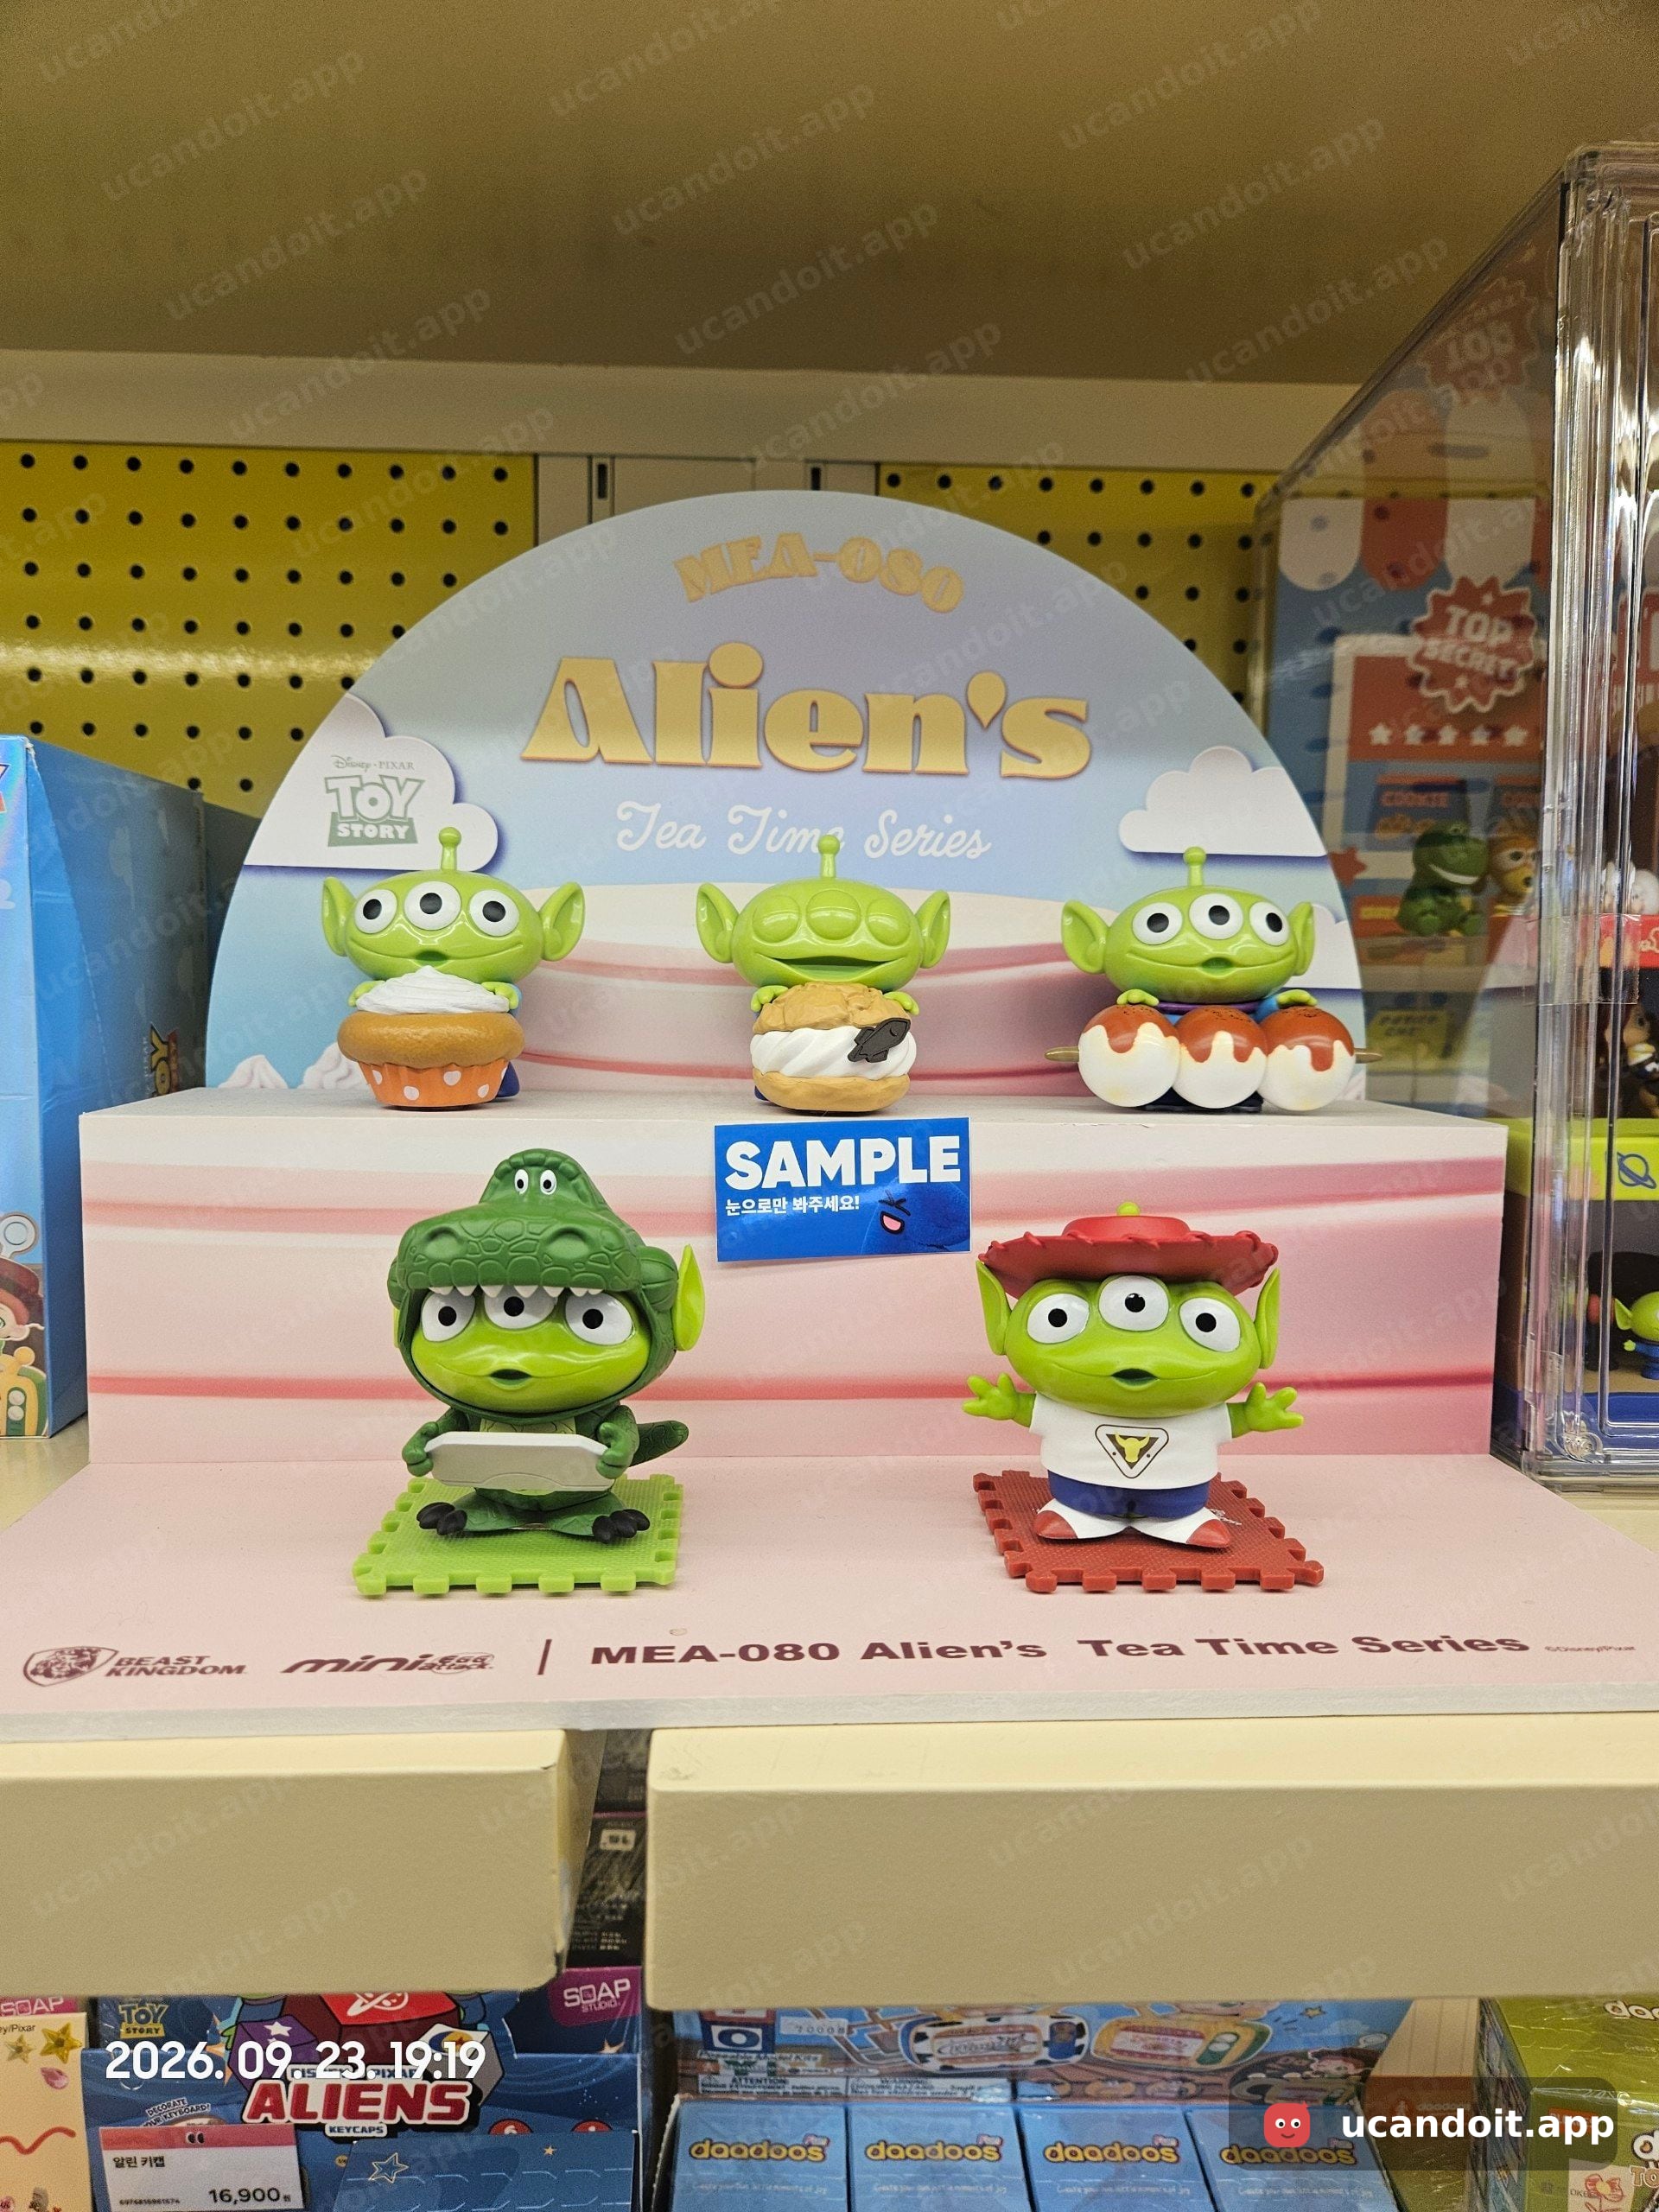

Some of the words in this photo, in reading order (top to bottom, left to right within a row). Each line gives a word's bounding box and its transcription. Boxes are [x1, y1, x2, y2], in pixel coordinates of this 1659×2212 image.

[674, 532, 965, 613] MEA-080
[1446, 605, 1513, 647] TOP
[1423, 637, 1518, 678] SECRET
[520, 642, 1092, 779] Alien's
[331, 754, 371, 772] Disney
[378, 761, 415, 770] PIXAR
[324, 774, 426, 820] TOY
[337, 823, 410, 840] STORY
[616, 800, 706, 851] Tea
[864, 810, 991, 859] Series
[149, 1023, 171, 1096] OY
[725, 1135, 962, 1191] SAMPLE
[726, 1197, 788, 1217] 눈으로만
[792, 1194, 860, 1214] 봐주세요!
[591, 1643, 840, 1664] MEA-080
[861, 1640, 1048, 1661] Alien's
[1077, 1639, 1185, 1657] Tea
[1195, 1637, 1338, 1656] Time
[1351, 1634, 1529, 1654] Series
[105, 1665, 246, 1677] KINGDOM
[114, 1656, 210, 1667] BEAST
[280, 1654, 434, 1674] mini
[563, 1978, 631, 2007] SOAP
[1, 1997, 64, 2017] SOAP
[118, 2003, 168, 2025] TOY
[582, 1999, 617, 2012] STUDIO
[125, 2026, 160, 2035] STORY
[146, 2097, 187, 2116] DECORATE
[163, 2104, 211, 2121] KEYBOARD!
[245, 2082, 469, 2121] ALIENS
[328, 2126, 384, 2134] KEYCAPS
[689, 2138, 827, 2161] daadoos
[865, 2139, 1002, 2162] daadoos
[1044, 2141, 1180, 2163] daadoos
[1220, 2144, 1357, 2164] daadoos
[112, 2157, 137, 2169] 알린
[141, 2156, 165, 2168] 키캡
[208, 2188, 280, 2205] 16,900
